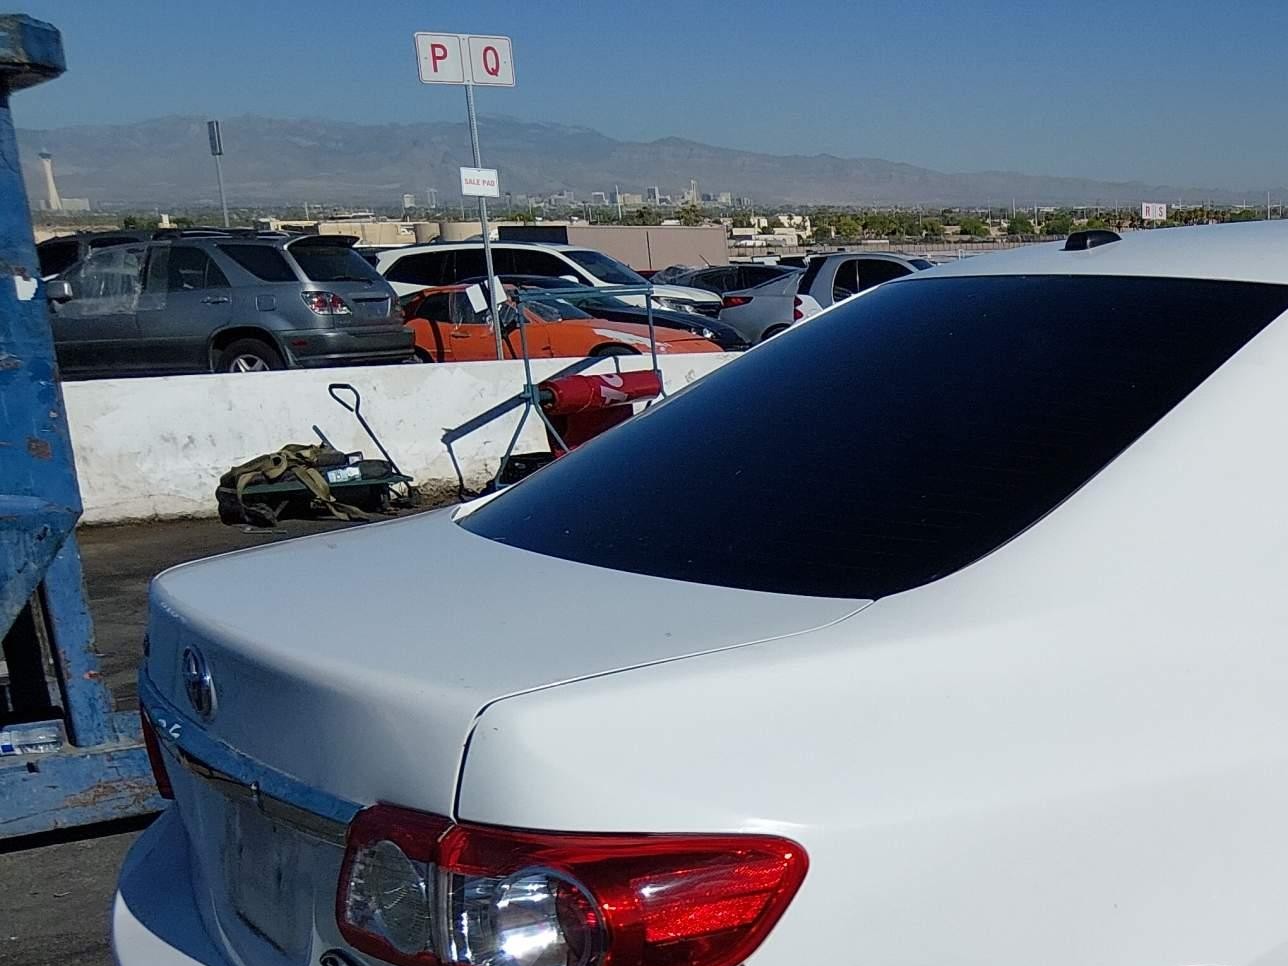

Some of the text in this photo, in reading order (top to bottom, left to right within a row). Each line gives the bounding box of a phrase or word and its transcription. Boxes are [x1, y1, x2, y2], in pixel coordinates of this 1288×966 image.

[431, 43, 500, 77] P Q
[464, 178, 496, 187] SALE PAD
[1145, 205, 1164, 217] R S
